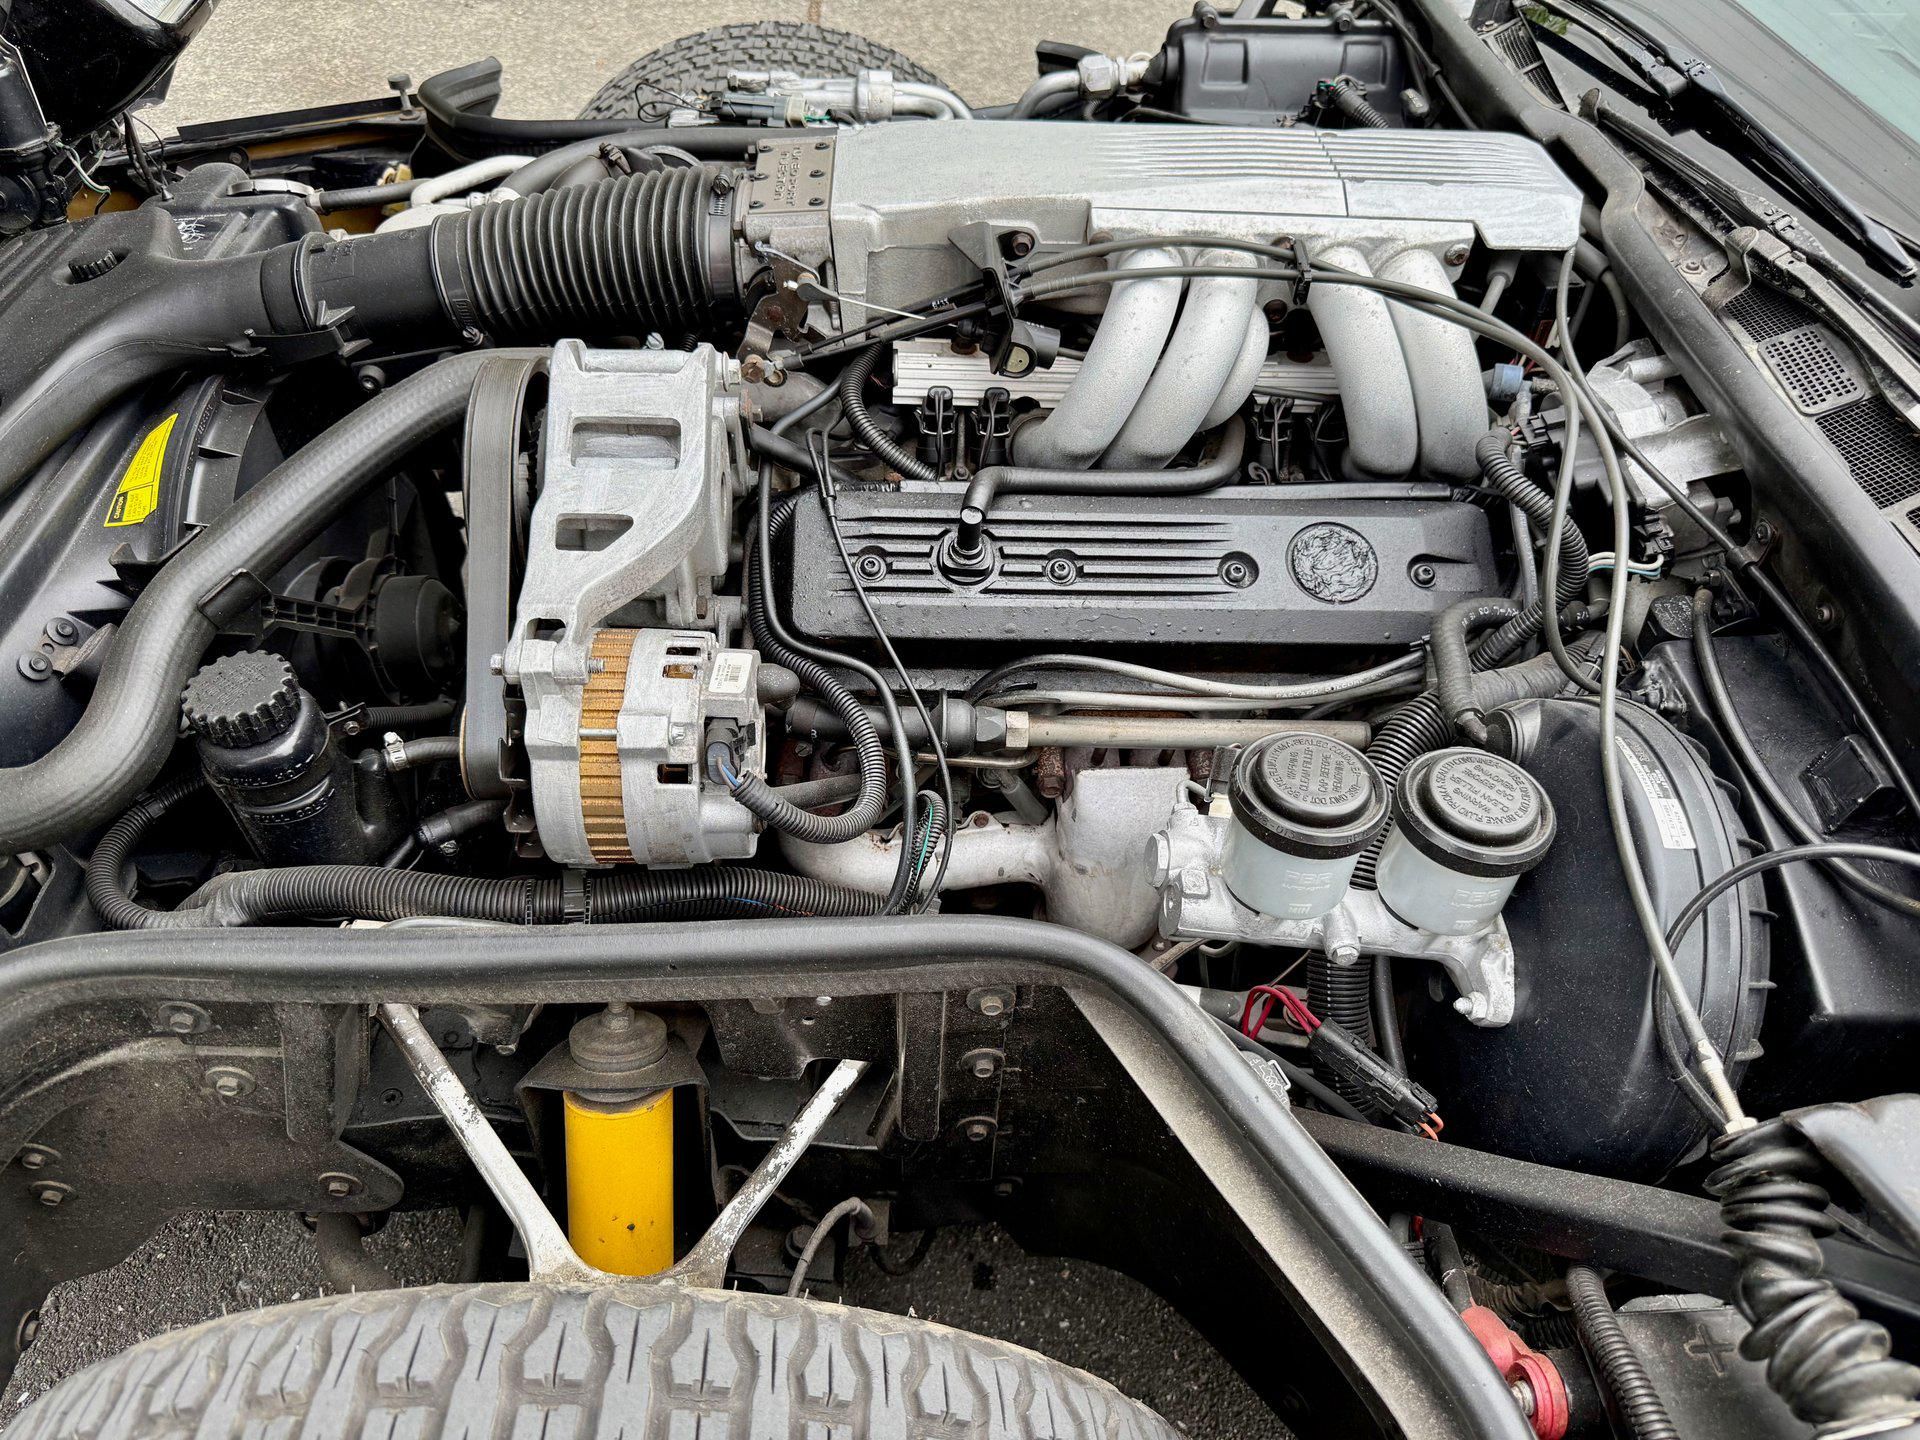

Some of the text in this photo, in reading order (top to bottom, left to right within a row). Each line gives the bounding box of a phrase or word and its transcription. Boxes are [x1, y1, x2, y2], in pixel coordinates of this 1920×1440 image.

[114, 496, 124, 519] CAUTION
[1318, 778, 1328, 793] CAP
[1462, 767, 1515, 801] CAP BEFORE
[1474, 764, 1517, 792] REMOVING
[1450, 774, 1510, 813] CLEAN FILLER
[1453, 787, 1491, 814] WARNING
